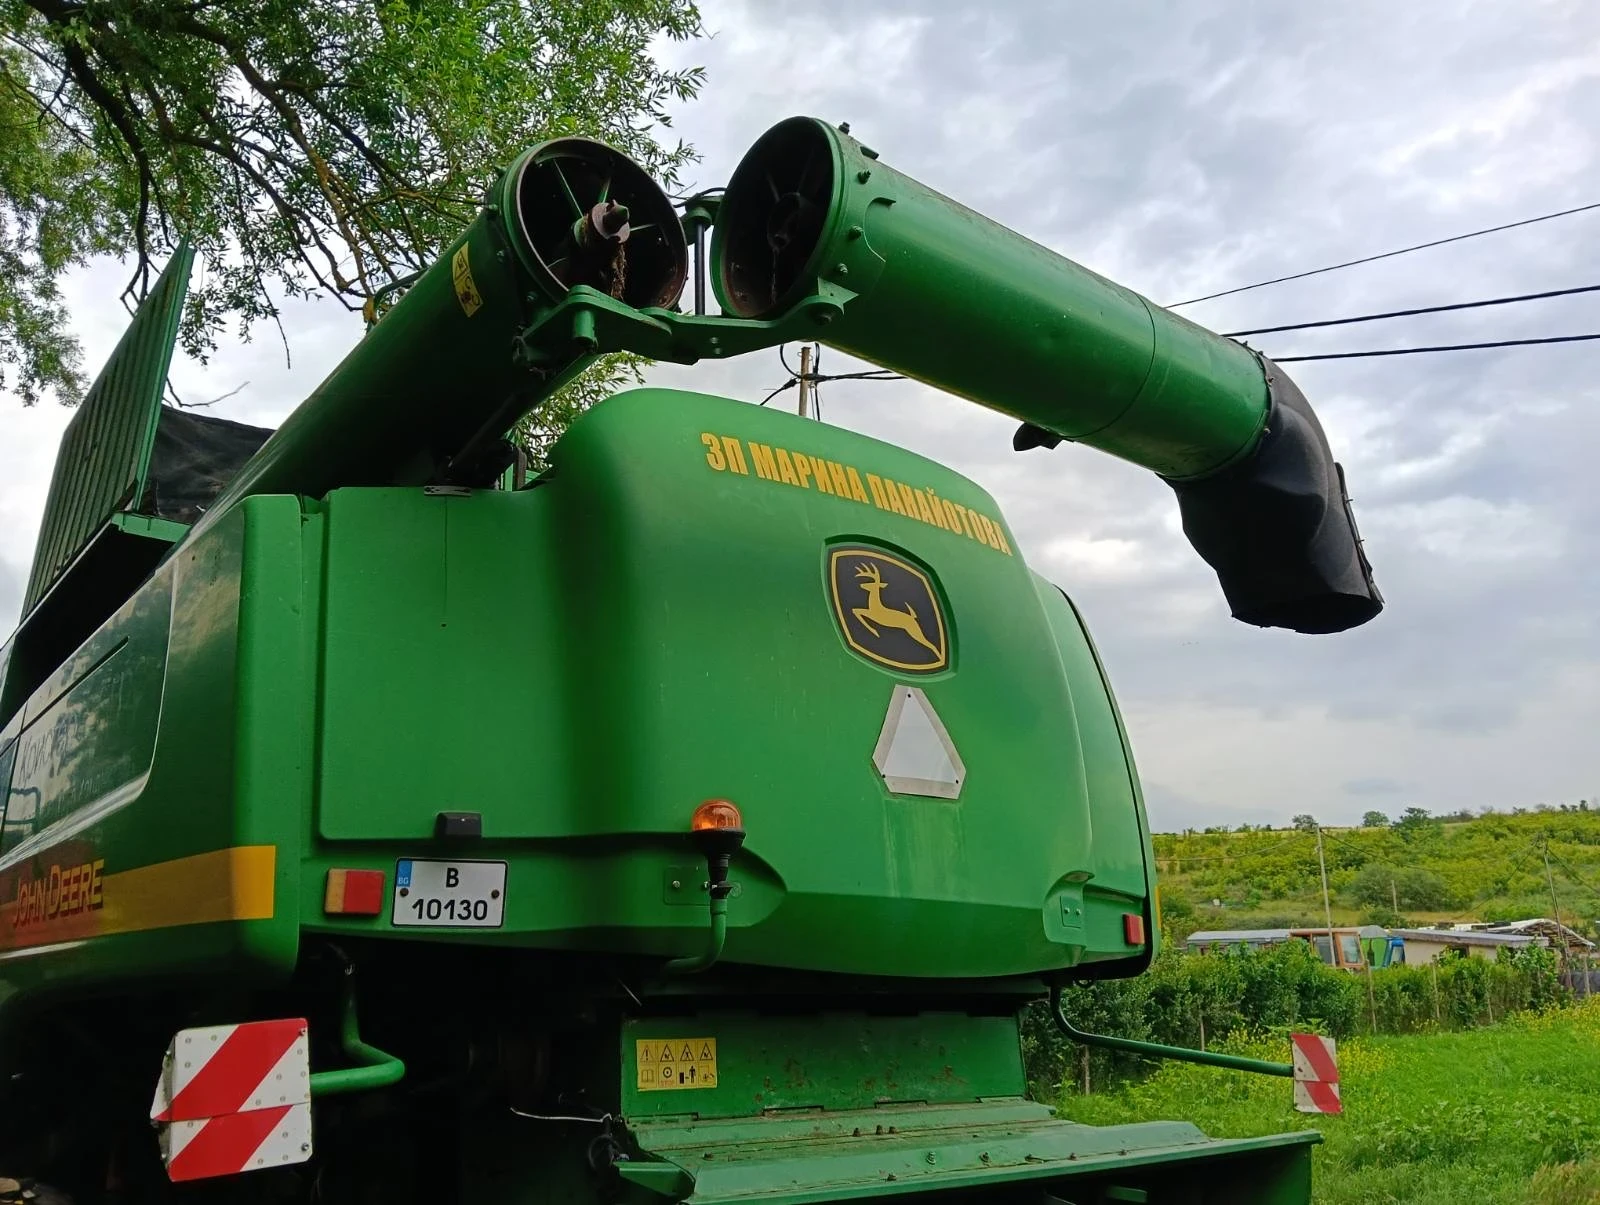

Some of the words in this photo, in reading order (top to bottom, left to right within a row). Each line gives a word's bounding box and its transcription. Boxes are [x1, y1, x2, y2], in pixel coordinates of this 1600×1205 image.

[700, 432, 749, 475] ЗП
[748, 442, 870, 505] МАРИНА
[866, 473, 1013, 556] ПАНАЙОТОВА
[398, 876, 409, 885] BG
[445, 867, 460, 888] B
[16, 878, 47, 925] JOHN
[48, 859, 104, 917] DEERE
[411, 898, 488, 921] 10130
